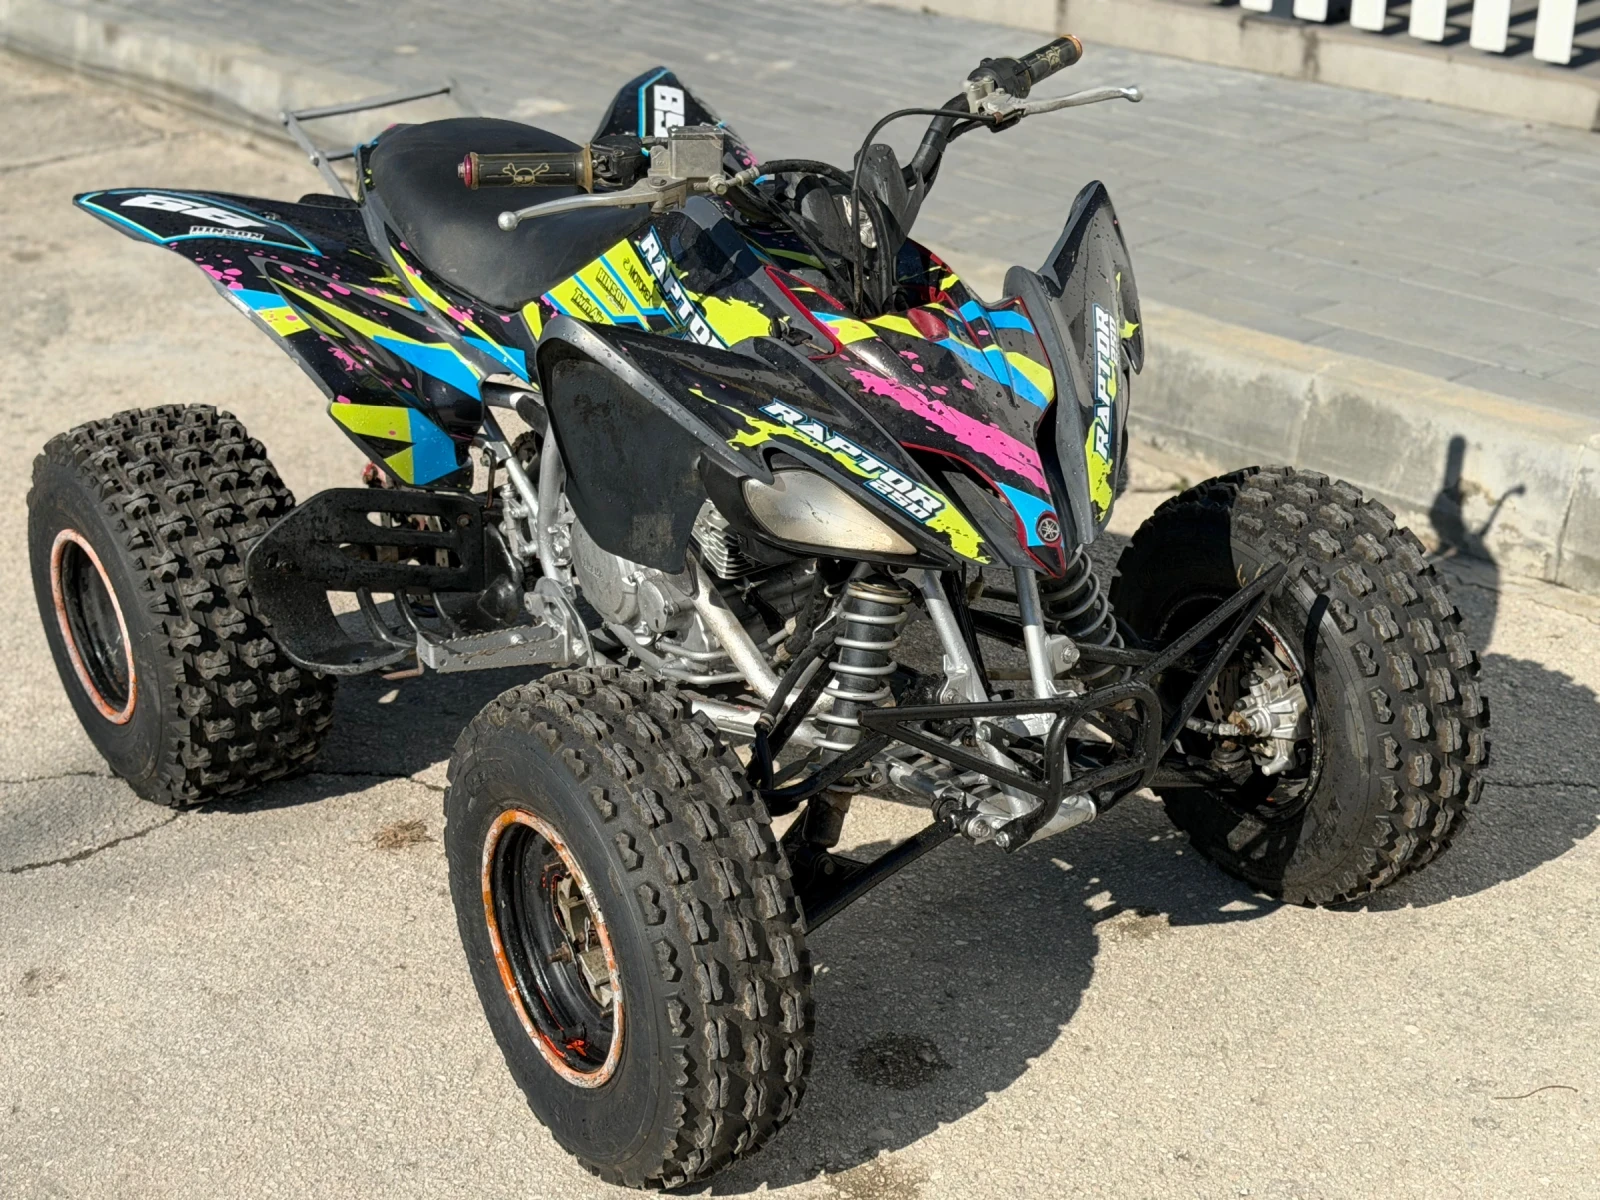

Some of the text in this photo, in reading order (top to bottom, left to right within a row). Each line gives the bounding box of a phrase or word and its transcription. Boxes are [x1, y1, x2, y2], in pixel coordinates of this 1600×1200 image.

[188, 225, 264, 240] HINSON
[571, 287, 604, 323] Twin Air
[596, 267, 628, 312] HINSON
[1093, 305, 1112, 463] RAPTOR
[763, 400, 945, 515] RAPTOR
[868, 478, 931, 519] 250
